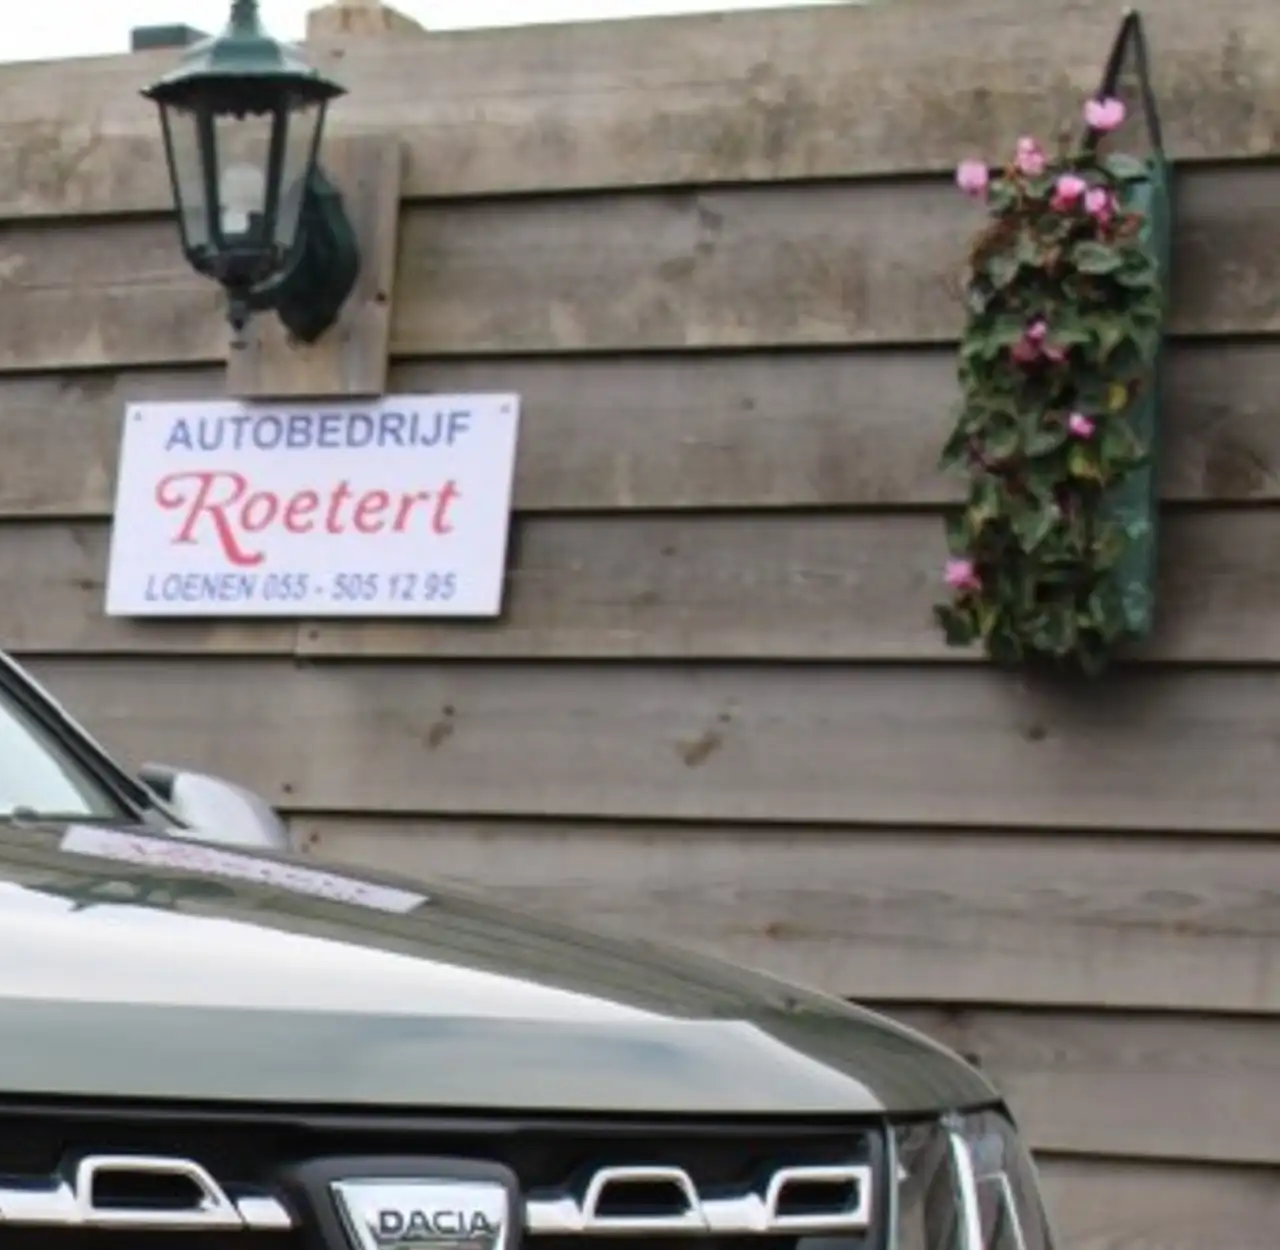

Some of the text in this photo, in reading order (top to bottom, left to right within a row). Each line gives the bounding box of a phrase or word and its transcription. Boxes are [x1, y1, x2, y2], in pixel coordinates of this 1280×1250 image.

[164, 409, 473, 451] AUTOBEDRIJF
[154, 468, 463, 567] Roetert
[143, 573, 256, 602] LOENEN
[262, 573, 309, 601] 055
[330, 573, 379, 601] 505
[388, 572, 414, 600] 12
[423, 572, 458, 600] 95
[378, 1210, 495, 1234] DACIA
